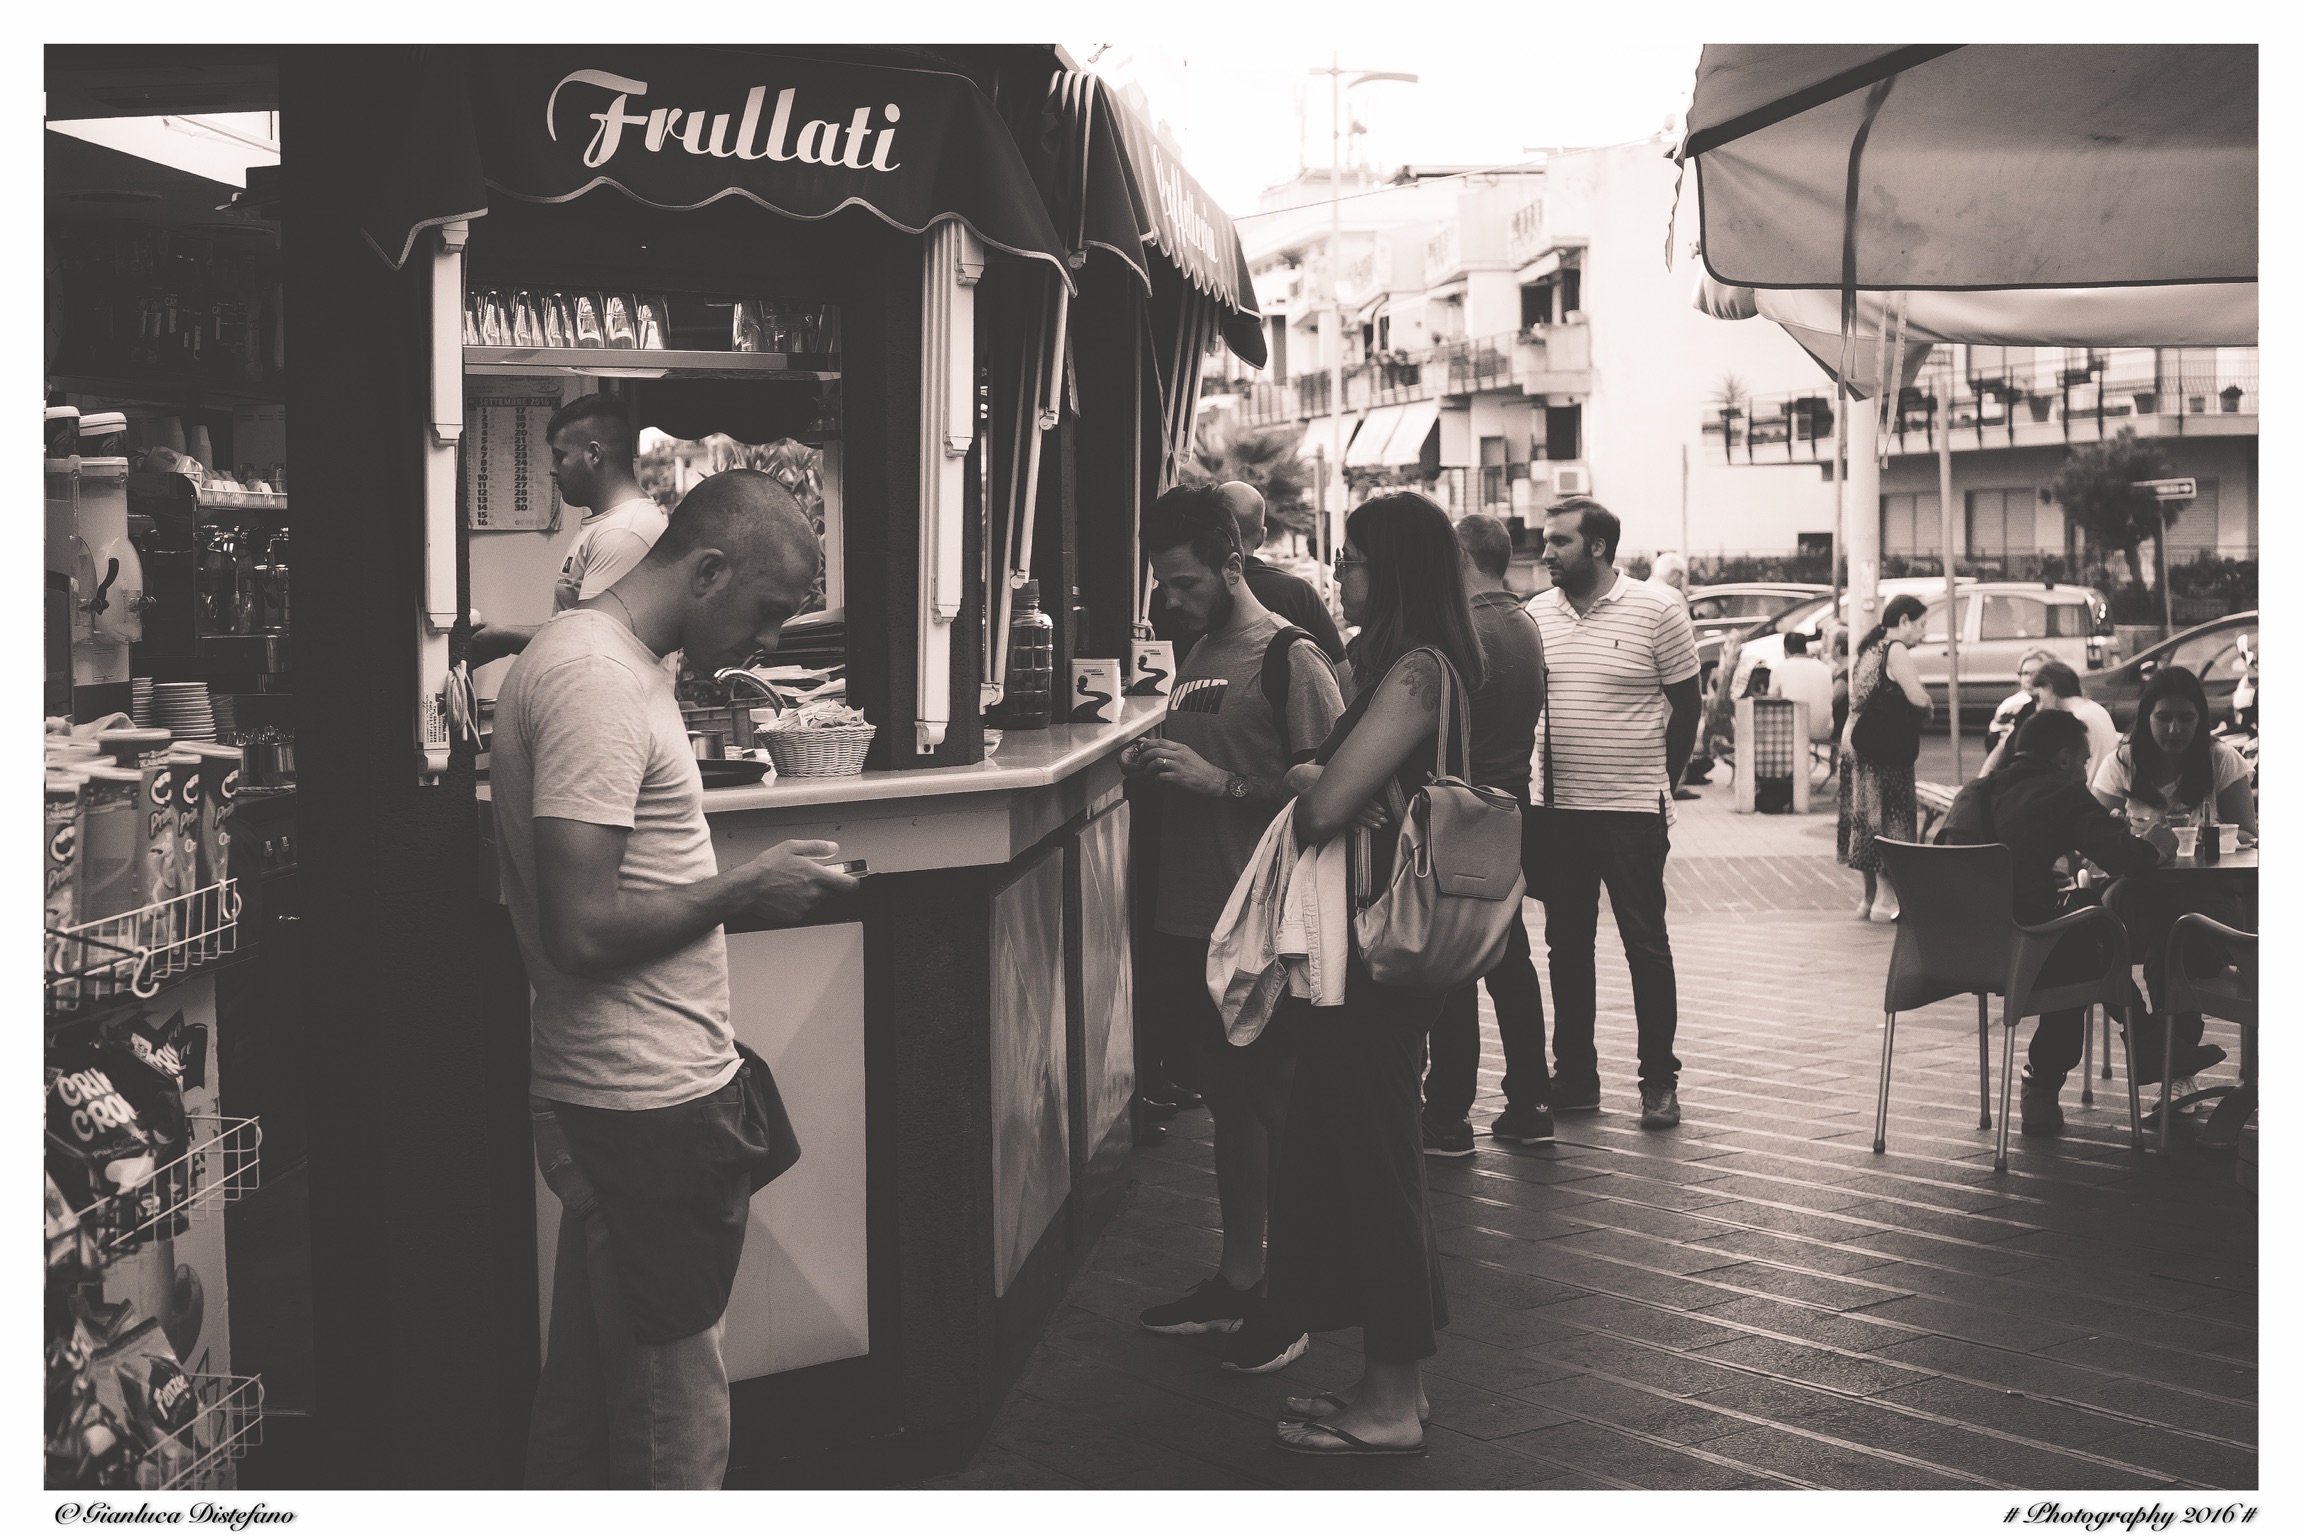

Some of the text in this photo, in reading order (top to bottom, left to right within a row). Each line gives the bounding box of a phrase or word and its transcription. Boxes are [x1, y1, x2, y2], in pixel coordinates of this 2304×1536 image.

[547, 69, 901, 172] Frullati
[479, 398, 550, 406] SETTEMBRE 2016
[1169, 678, 1228, 715] UMA
